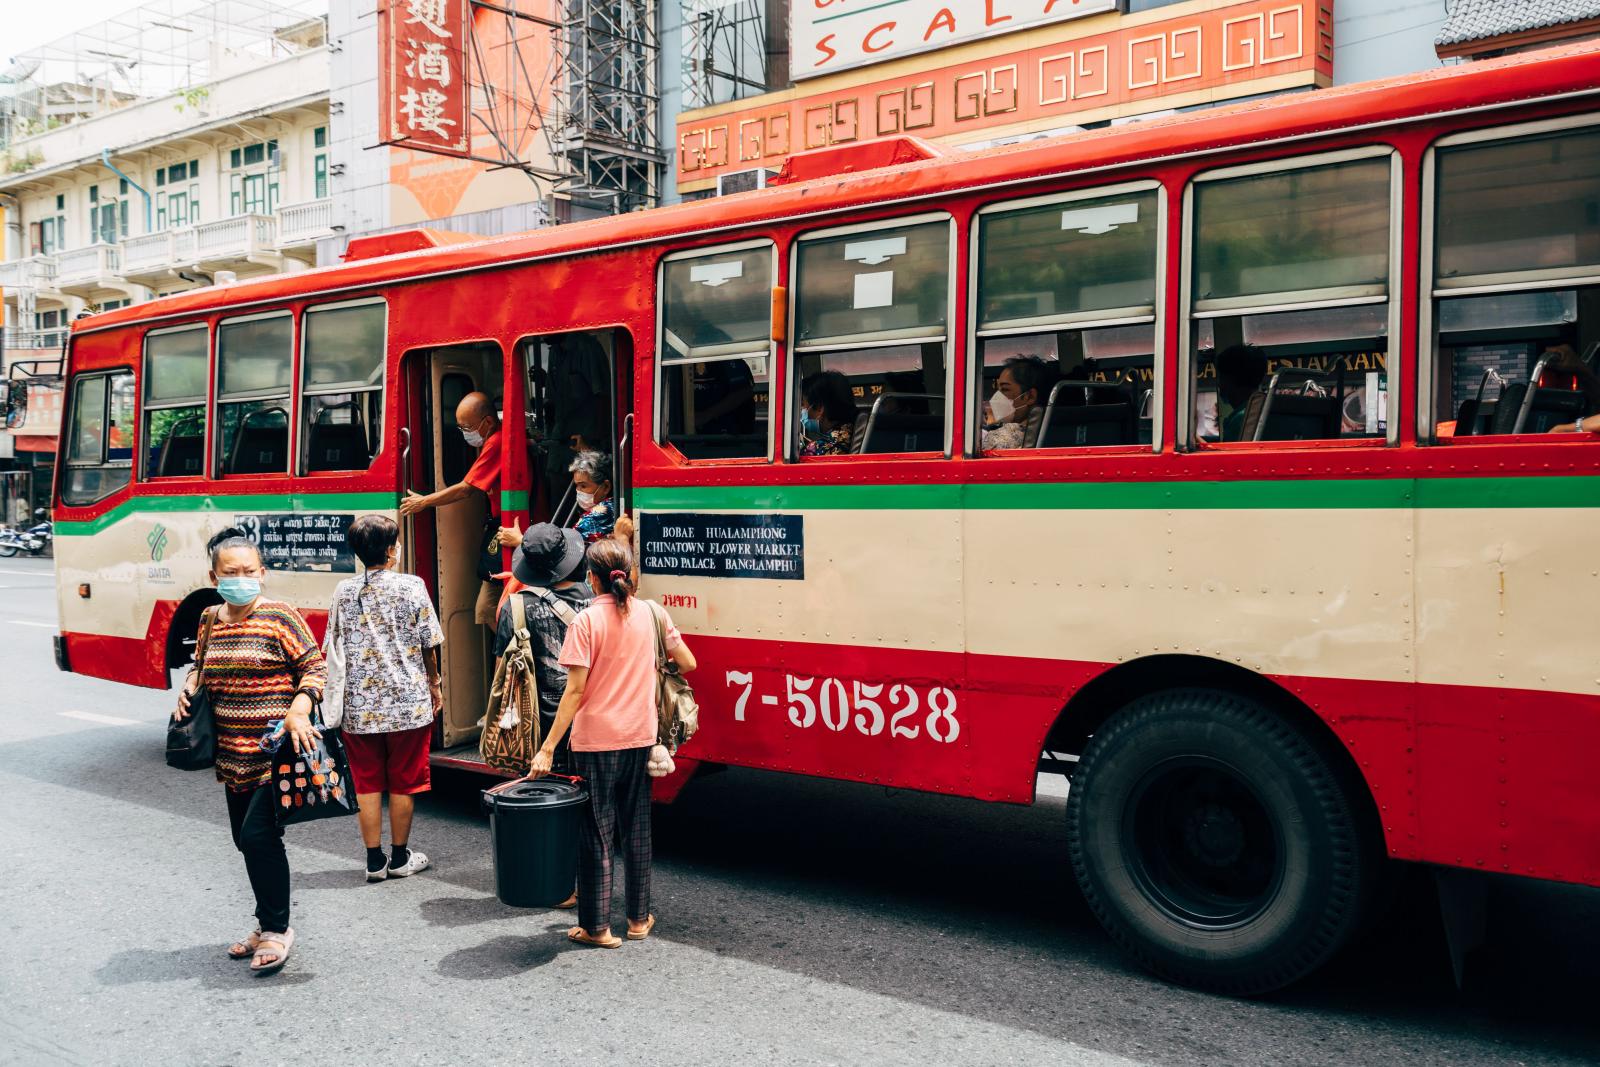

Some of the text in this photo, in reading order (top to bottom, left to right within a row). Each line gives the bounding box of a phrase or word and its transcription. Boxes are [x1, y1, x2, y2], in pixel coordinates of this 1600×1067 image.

[662, 527, 787, 539] BOBAE HUALAMPHONG
[646, 541, 801, 556] CHINATOWN FLOWER MARKET
[645, 556, 797, 572] GRAND PALACE BANGLAMPHU
[726, 670, 960, 743] 7-50528
